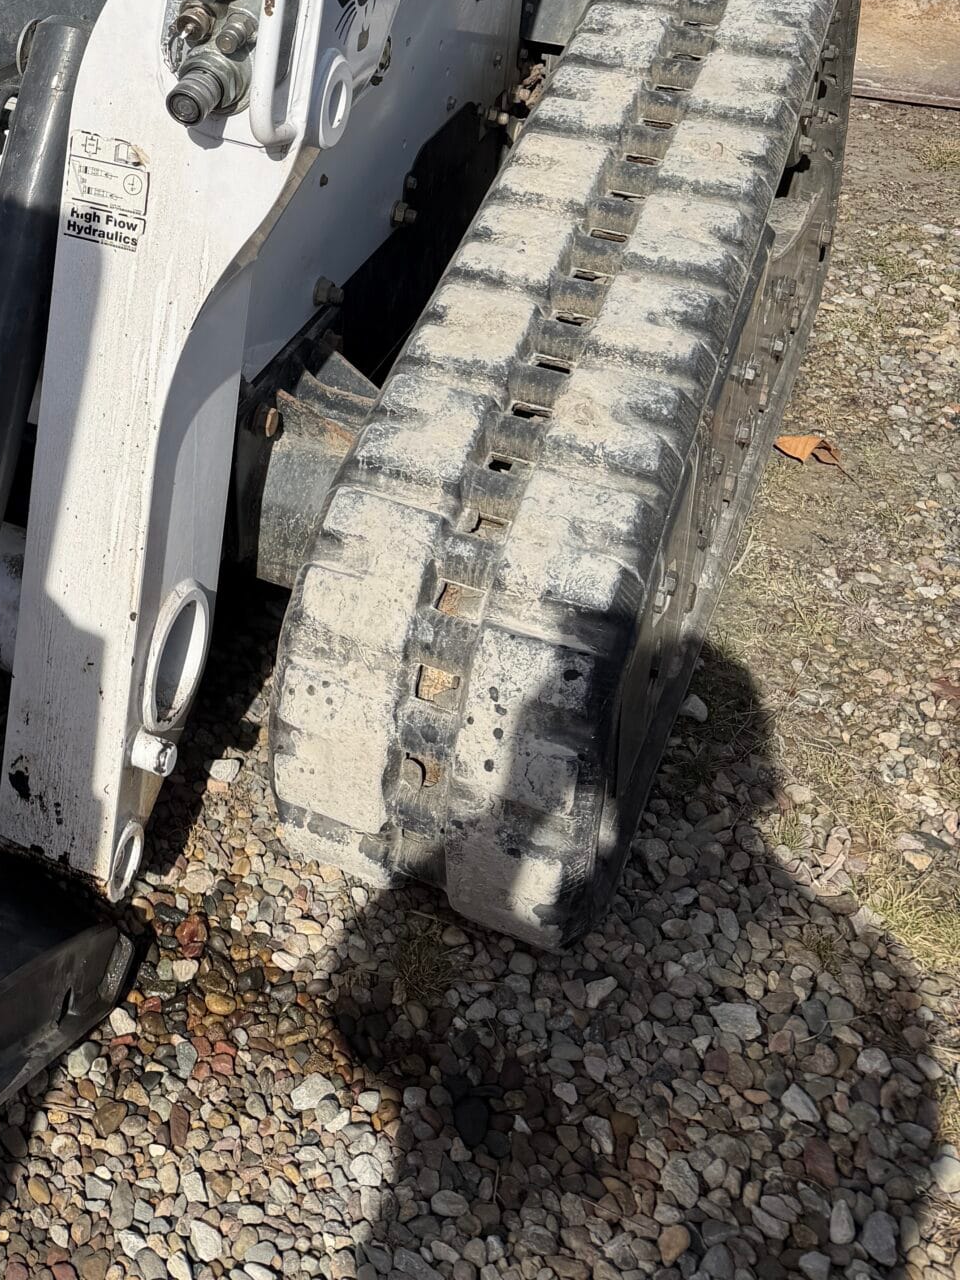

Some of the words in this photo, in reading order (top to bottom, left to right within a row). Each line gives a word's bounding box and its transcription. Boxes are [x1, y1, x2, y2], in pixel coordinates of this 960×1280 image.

[70, 206, 101, 224] High
[105, 215, 138, 232] Flow
[67, 220, 138, 246] Hydraulics
